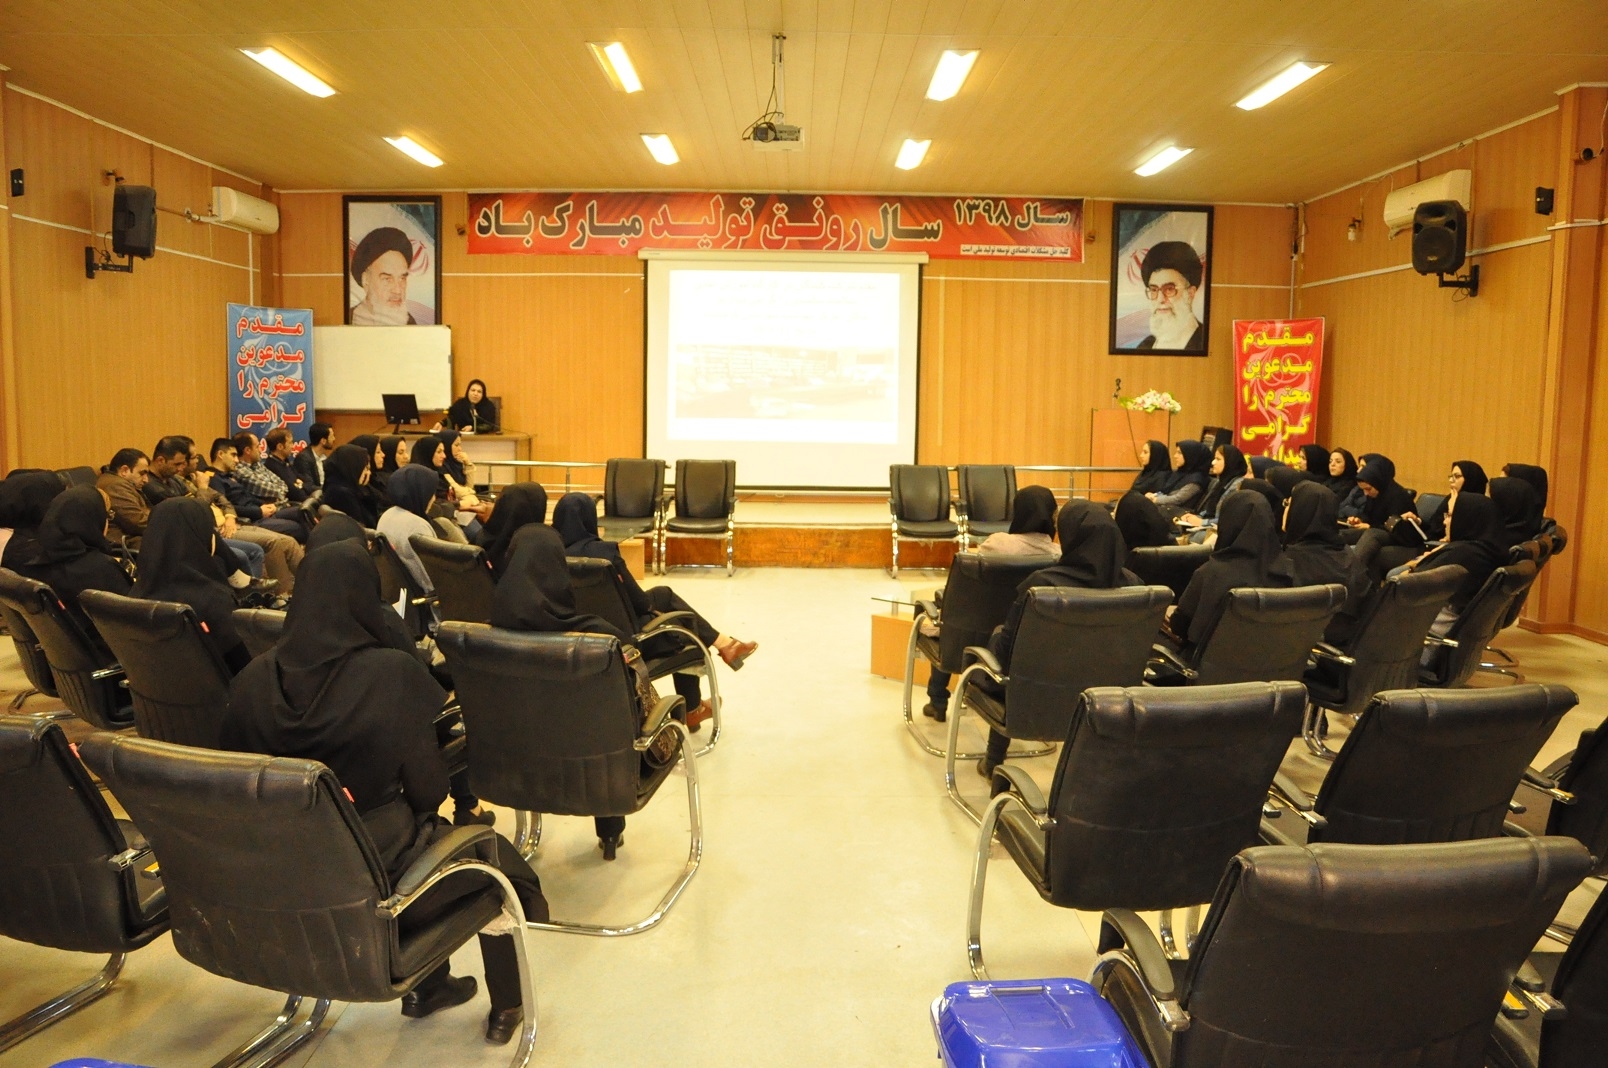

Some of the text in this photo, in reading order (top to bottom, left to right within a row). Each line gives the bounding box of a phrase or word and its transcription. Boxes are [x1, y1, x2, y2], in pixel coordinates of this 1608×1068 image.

[475, 194, 942, 250] سال رونق تولید مبارک باد
[953, 198, 1071, 229] سال ۱۳۹۸
[236, 314, 305, 338] مقدم
[1243, 326, 1314, 354] مقدم
[236, 345, 305, 367] مدعوین
[1243, 358, 1314, 380] مدعوین
[237, 369, 306, 399] محترم را
[1243, 384, 1312, 411] محترم را
[237, 402, 307, 429] گرامی
[1241, 413, 1312, 441] گرامی
